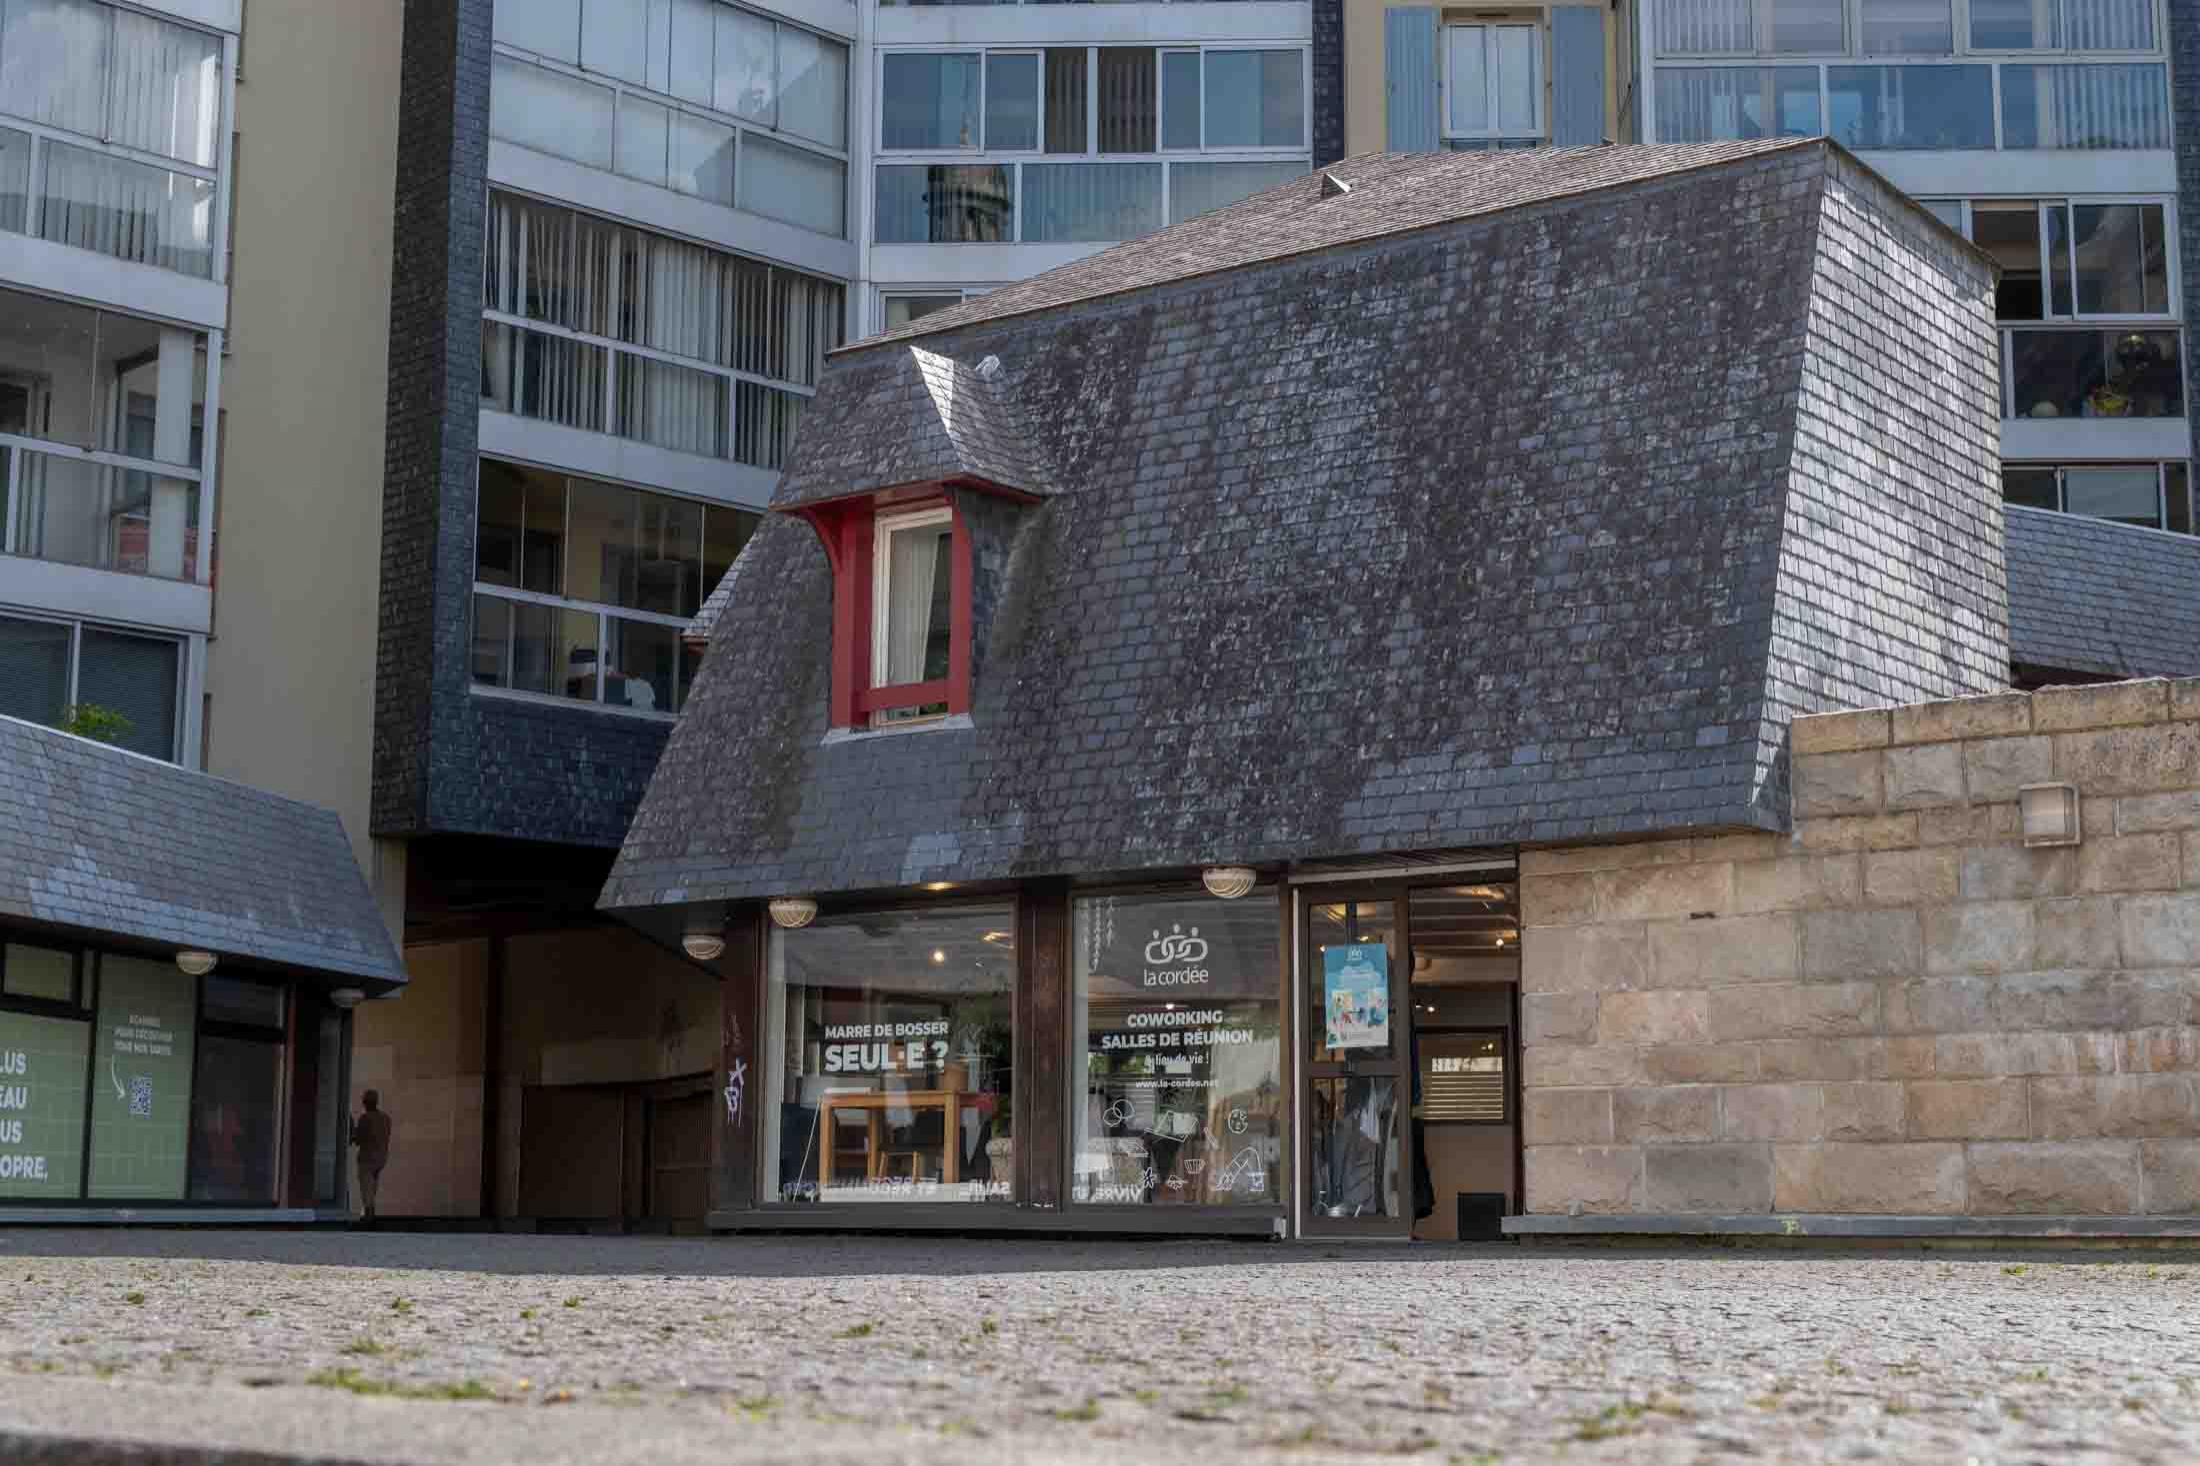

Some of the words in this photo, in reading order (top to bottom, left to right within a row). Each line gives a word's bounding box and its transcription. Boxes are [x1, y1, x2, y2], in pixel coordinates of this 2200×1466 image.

[1144, 969, 1156, 985] la
[1158, 965, 1208, 985] cordée
[1128, 1010, 1223, 1028] COWORKING
[825, 1024, 872, 1039] MARRE
[874, 1023, 893, 1037] DE
[896, 1021, 948, 1036] BOSSER
[1102, 1033, 1156, 1049] SALLES
[1159, 1032, 1180, 1047] DE
[1184, 1028, 1253, 1046] RÉUNION
[1189, 1051, 1204, 1064] vie
